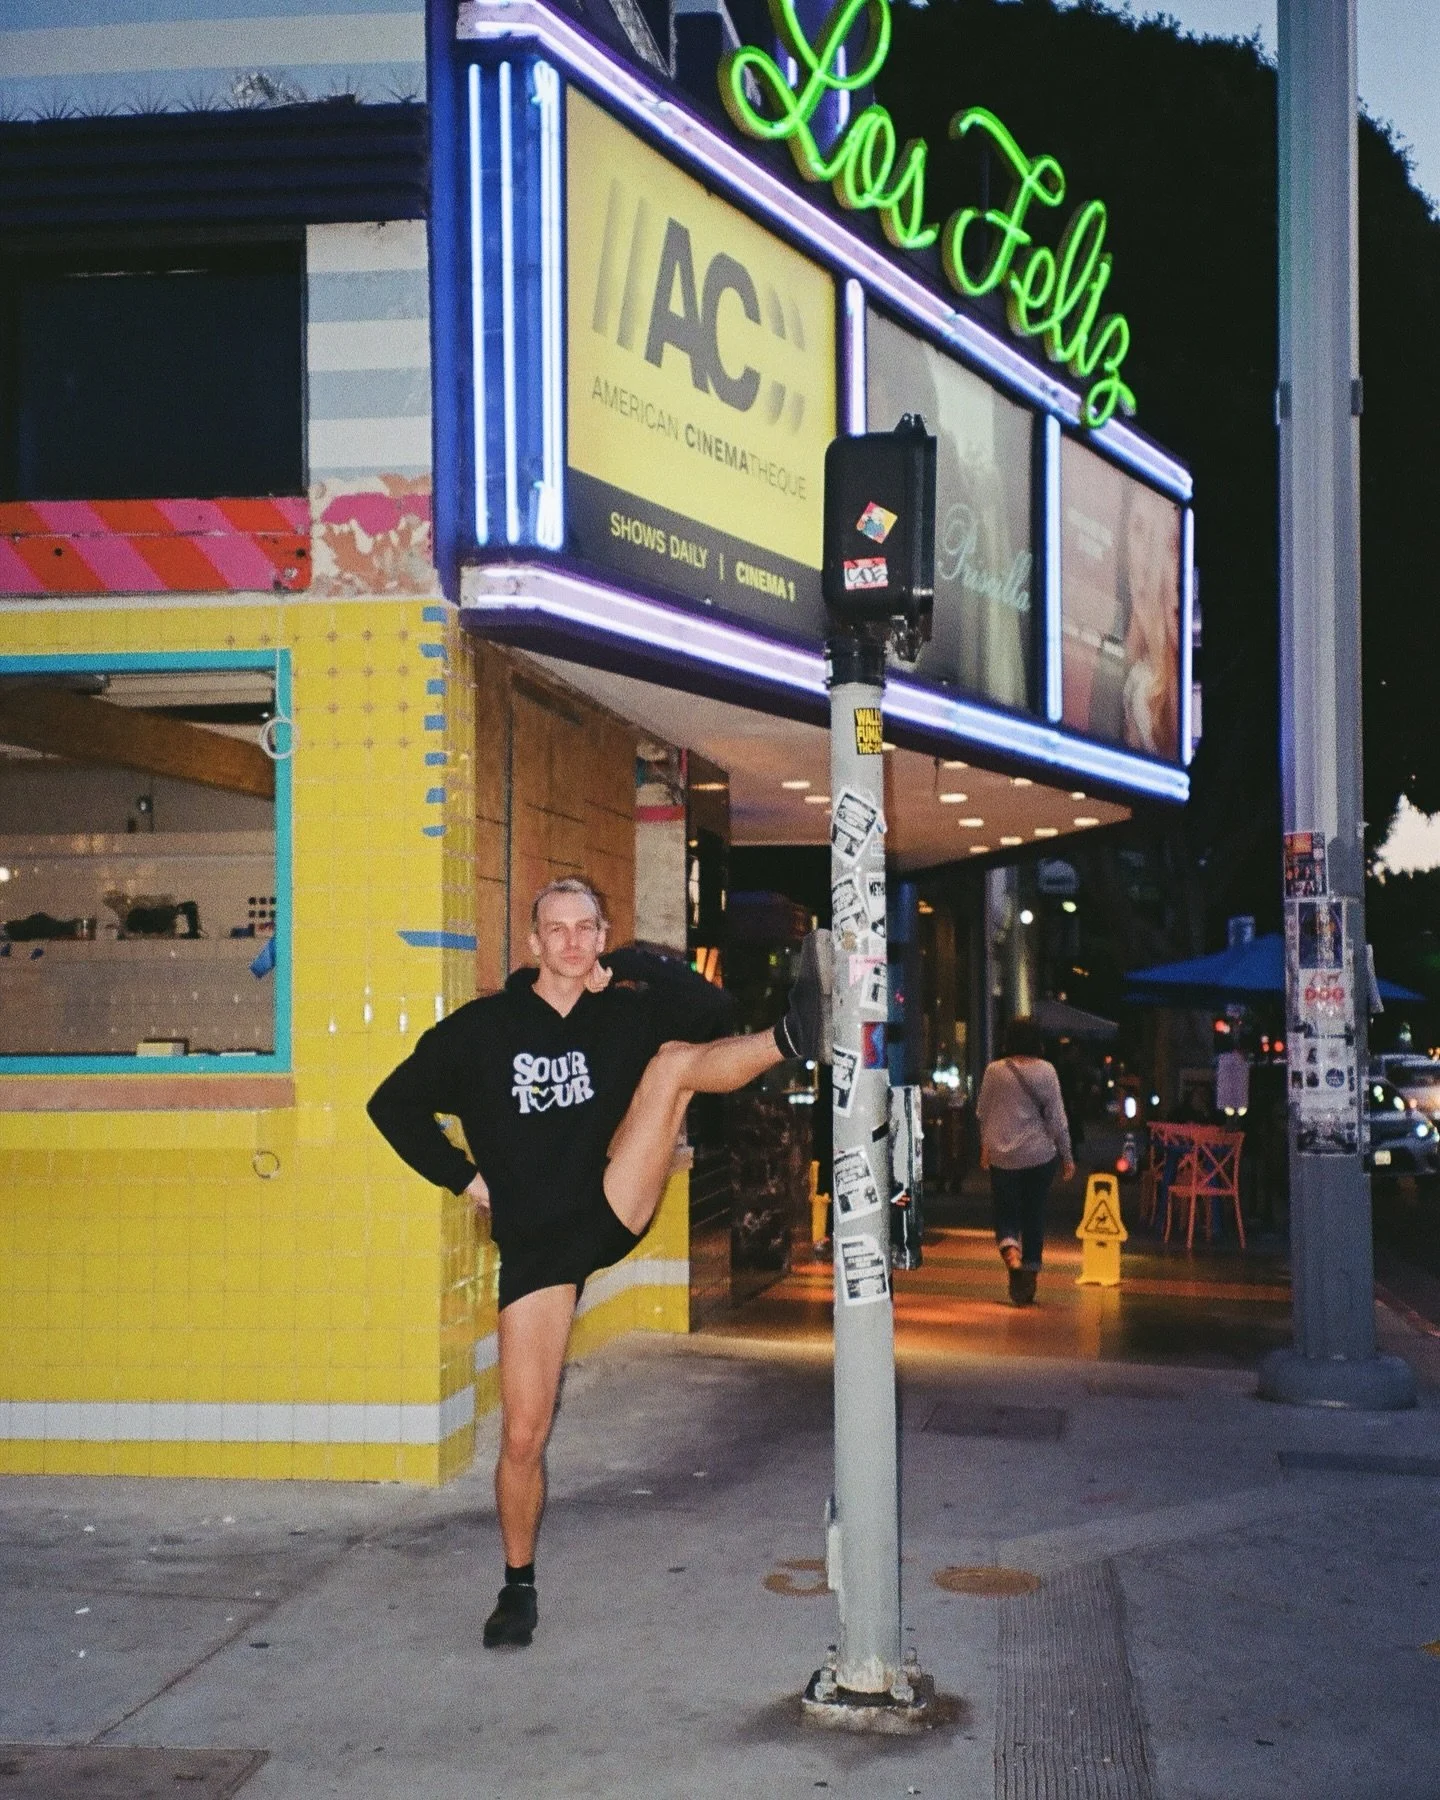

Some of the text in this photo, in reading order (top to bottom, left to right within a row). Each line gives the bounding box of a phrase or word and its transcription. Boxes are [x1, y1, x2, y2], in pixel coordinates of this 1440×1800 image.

[718, 0, 1137, 429] Los Feliz
[591, 375, 808, 501] AMERICAN CINEMATHEQUE
[610, 511, 667, 555] SHOWS
[670, 533, 708, 570] DAILY
[735, 560, 786, 599] CINEMA
[513, 1051, 589, 1086] SOUR
